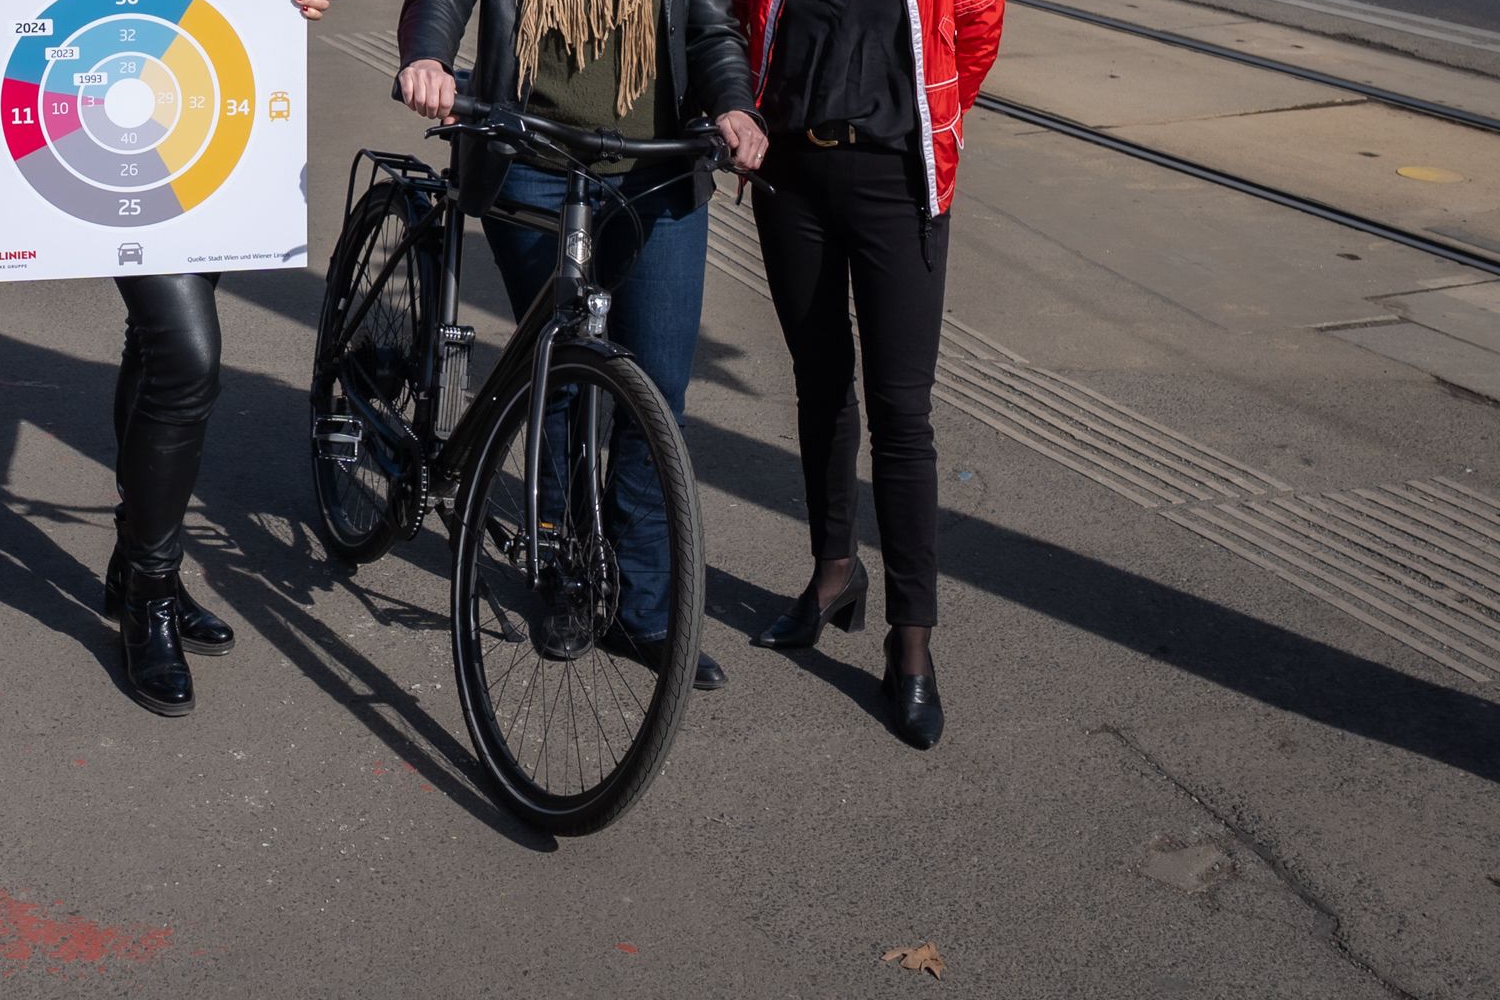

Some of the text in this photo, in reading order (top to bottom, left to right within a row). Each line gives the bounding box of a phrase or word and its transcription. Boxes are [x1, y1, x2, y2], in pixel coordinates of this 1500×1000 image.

[15, 22, 46, 34] 2024
[119, 29, 137, 41] 32
[50, 49, 74, 58] 2023
[119, 61, 137, 74] 28
[79, 74, 102, 83] 1993
[87, 96, 95, 107] 3
[157, 92, 174, 104] 29
[188, 96, 205, 109] 32
[51, 102, 69, 115] 10
[226, 99, 251, 116] 34
[11, 107, 35, 124] 11
[120, 132, 138, 144] 40
[120, 163, 139, 176] 26
[118, 199, 141, 215] 25
